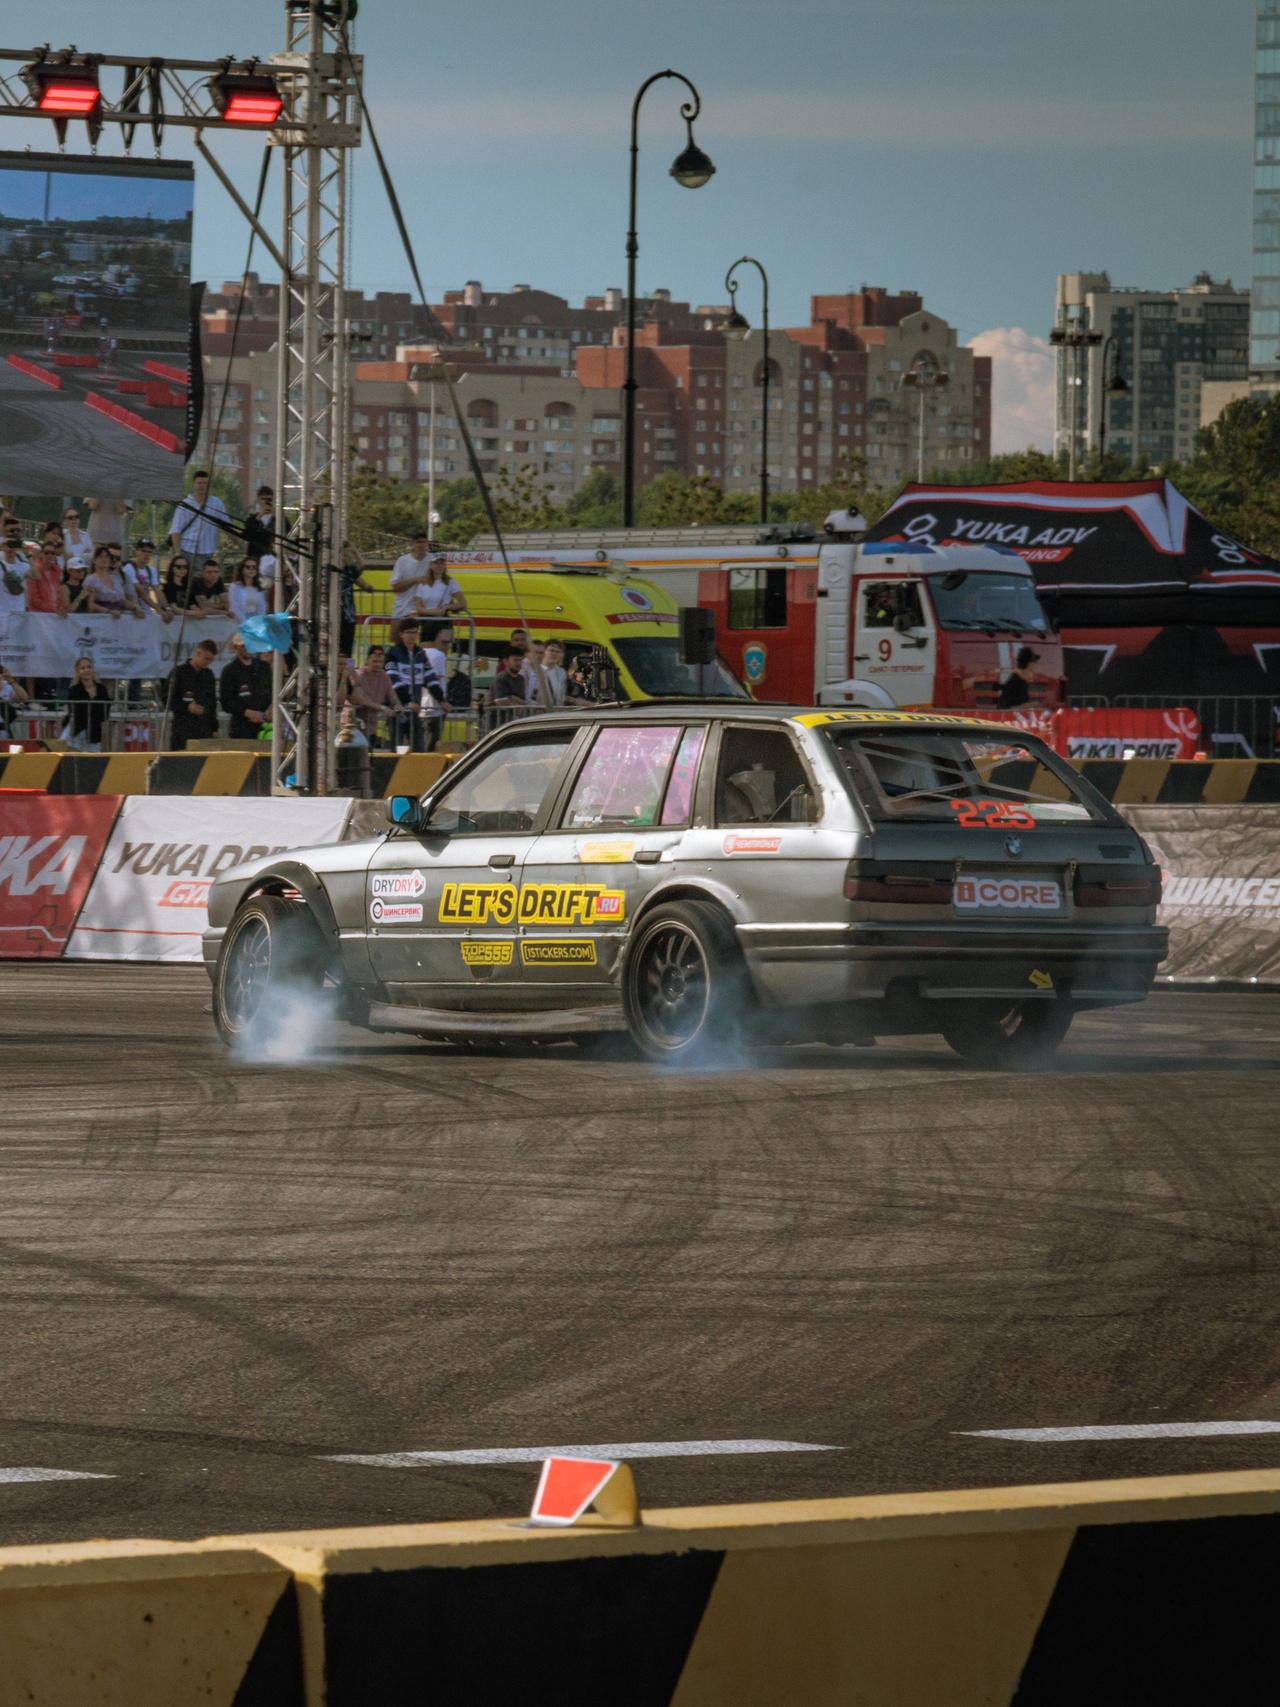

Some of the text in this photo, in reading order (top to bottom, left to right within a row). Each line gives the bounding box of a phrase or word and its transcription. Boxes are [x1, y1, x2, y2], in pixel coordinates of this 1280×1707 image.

[950, 518, 1099, 545] YUKA ADV
[878, 639, 892, 662] 9
[950, 799, 1035, 829] 225
[112, 842, 209, 877] YUKA
[373, 879, 413, 893] DRYDRY
[1161, 877, 1280, 905] ШИНСЕ
[384, 908, 421, 916] ШИНСЕРВИС
[442, 889, 513, 918] LET'S
